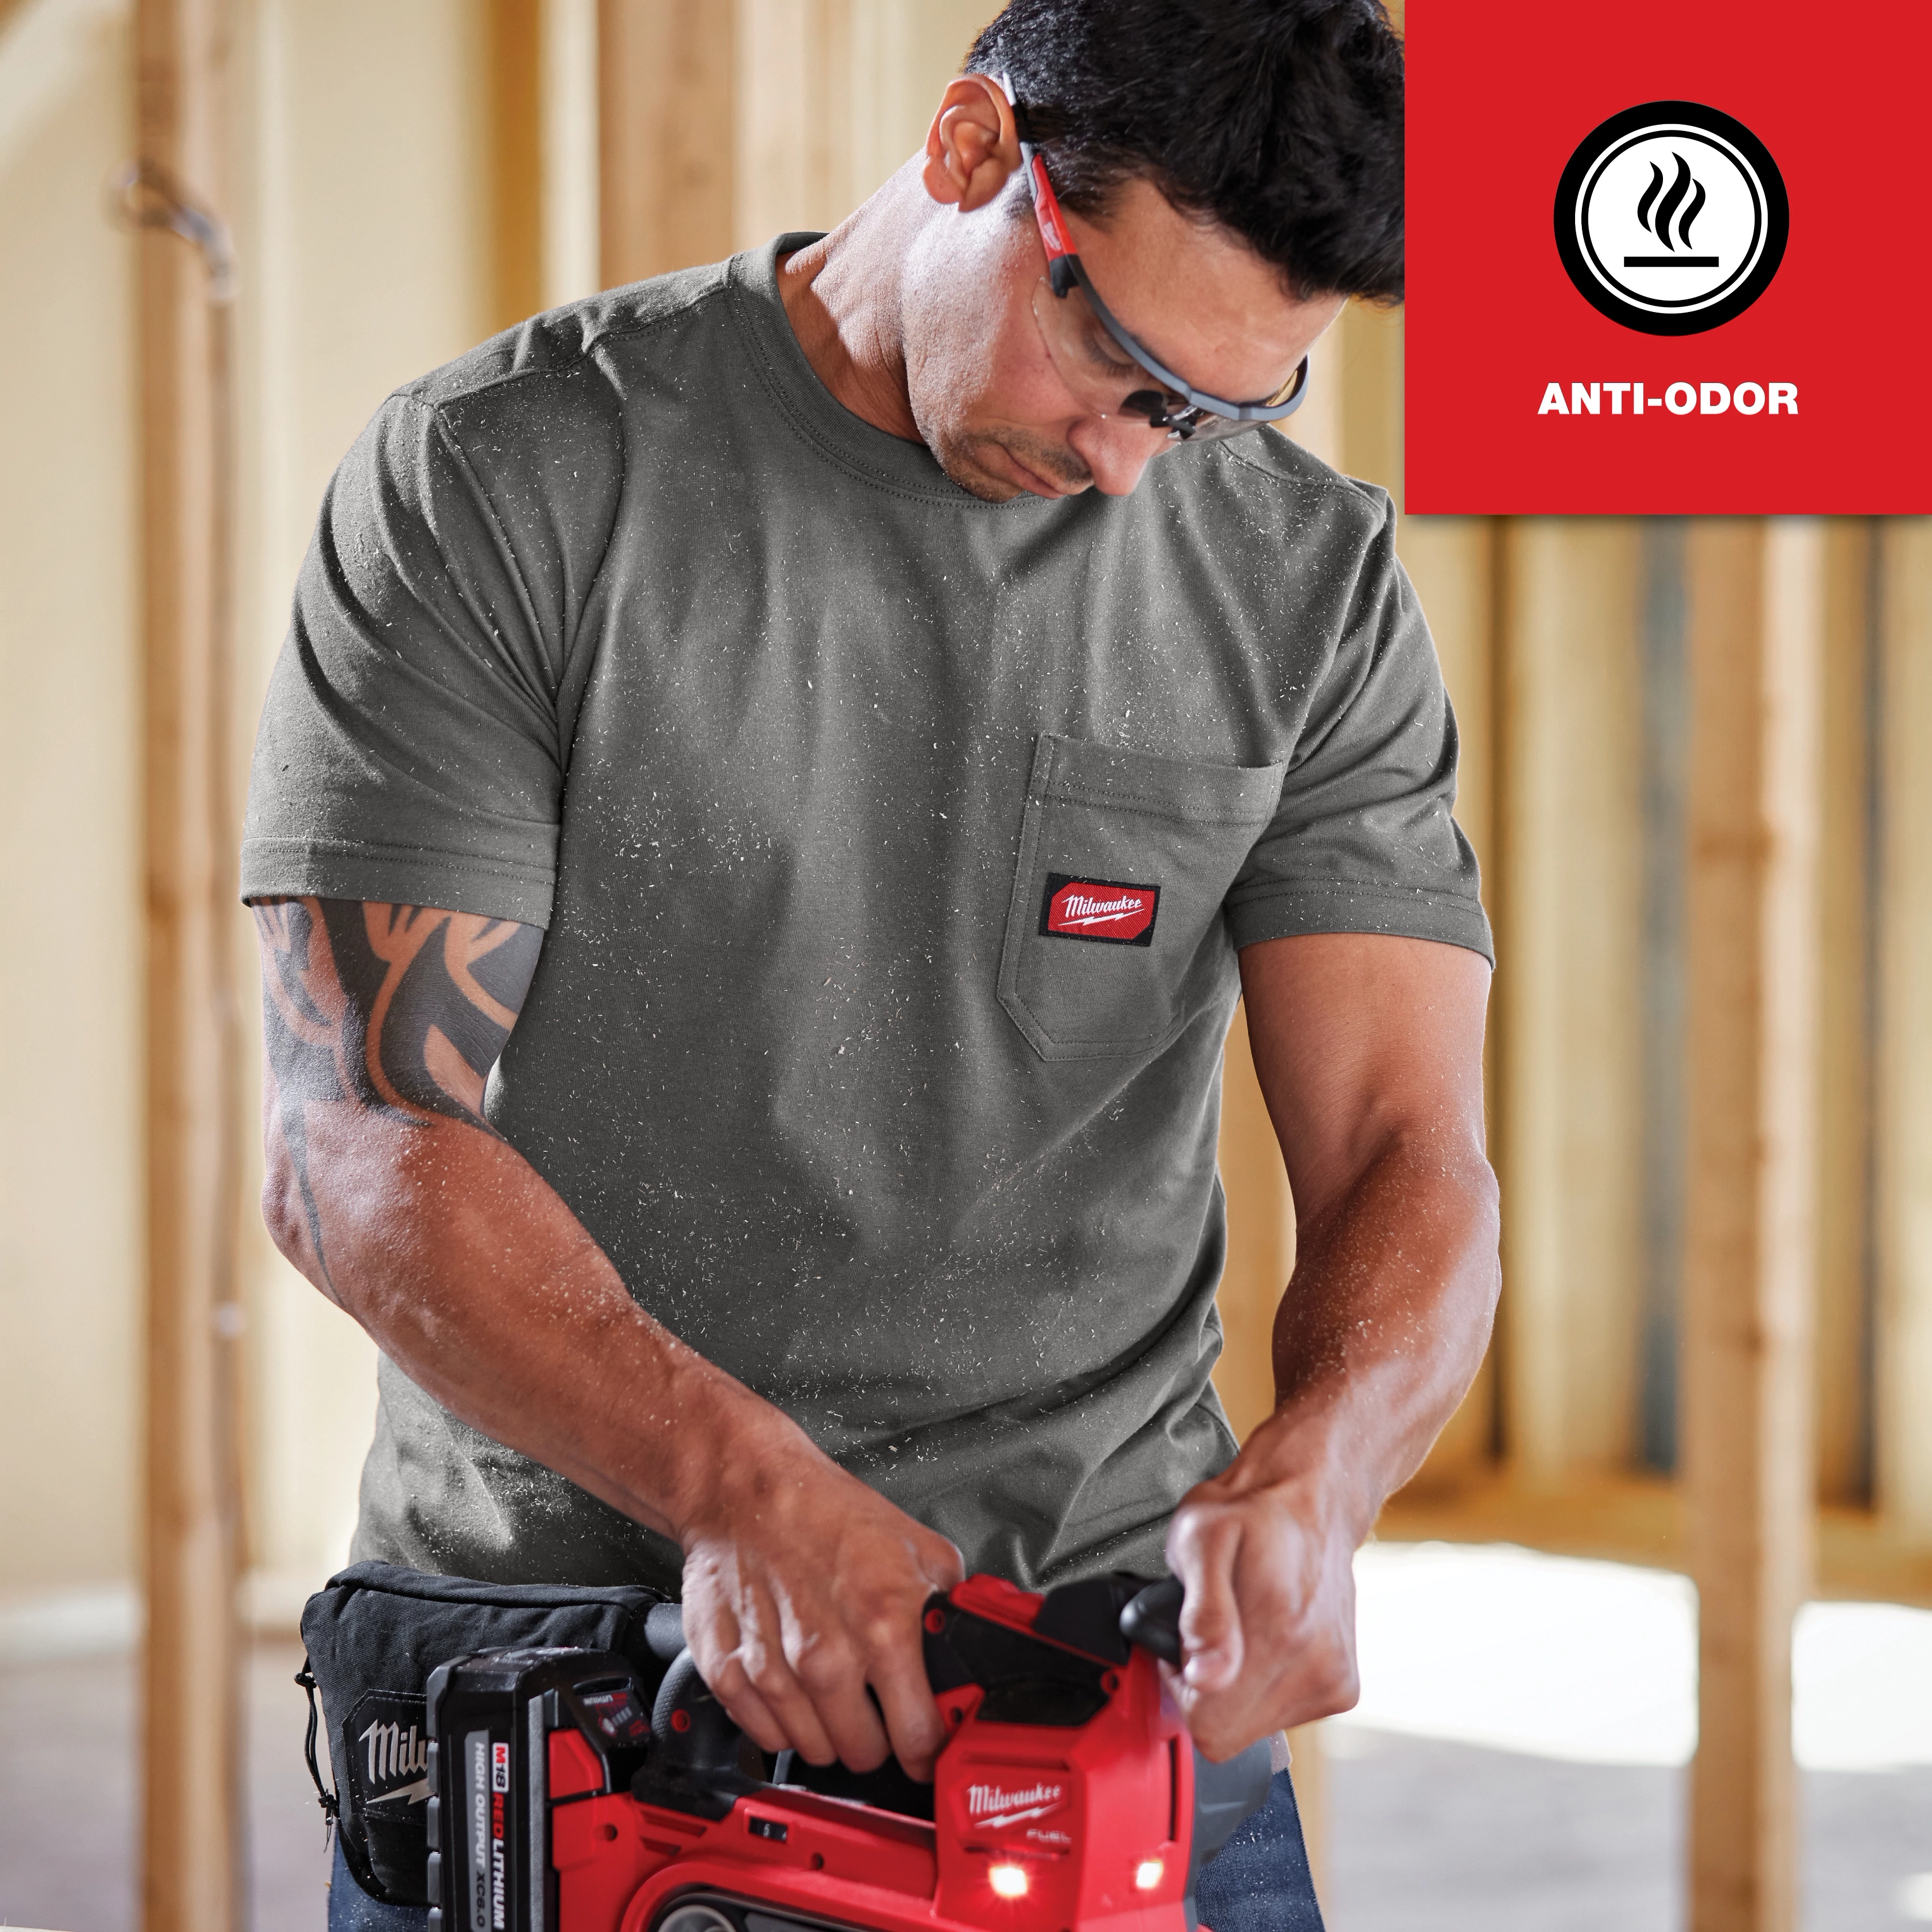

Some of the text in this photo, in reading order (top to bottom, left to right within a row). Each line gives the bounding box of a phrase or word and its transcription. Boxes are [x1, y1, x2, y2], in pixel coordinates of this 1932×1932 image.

[1061, 894, 1143, 918] Milwaukee
[475, 1742, 485, 1790] HIGH
[496, 1745, 506, 1788] M18
[966, 1781, 1061, 1816] Milwaukee
[475, 1793, 485, 1869] OUTPUT
[1026, 1828, 1072, 1844] FUEL
